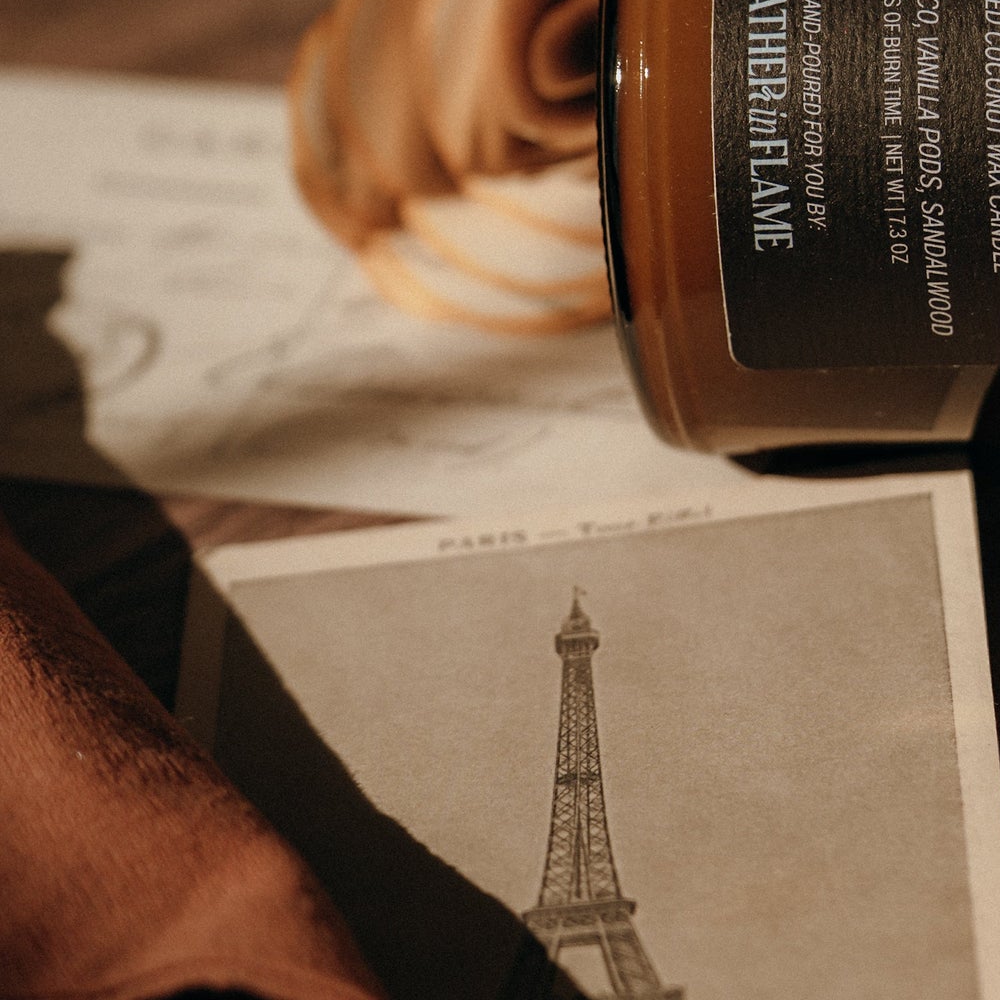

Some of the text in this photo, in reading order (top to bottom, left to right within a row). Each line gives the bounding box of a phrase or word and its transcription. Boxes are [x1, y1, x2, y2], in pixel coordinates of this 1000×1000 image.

[883, 12, 901, 32] OF
[883, 37, 902, 83] BURN
[916, 36, 941, 121] VANILLA
[884, 88, 902, 126] TIME
[804, 121, 822, 156] FOR
[885, 144, 903, 174] NET
[915, 127, 943, 193] PODS,
[749, 139, 794, 250] FLAME
[804, 162, 824, 199] YOU
[886, 177, 903, 202] WT
[806, 203, 825, 230] BY:
[887, 215, 906, 238] 7.3
[889, 243, 907, 263] OZ
[920, 200, 953, 336] SANDALWOOD
